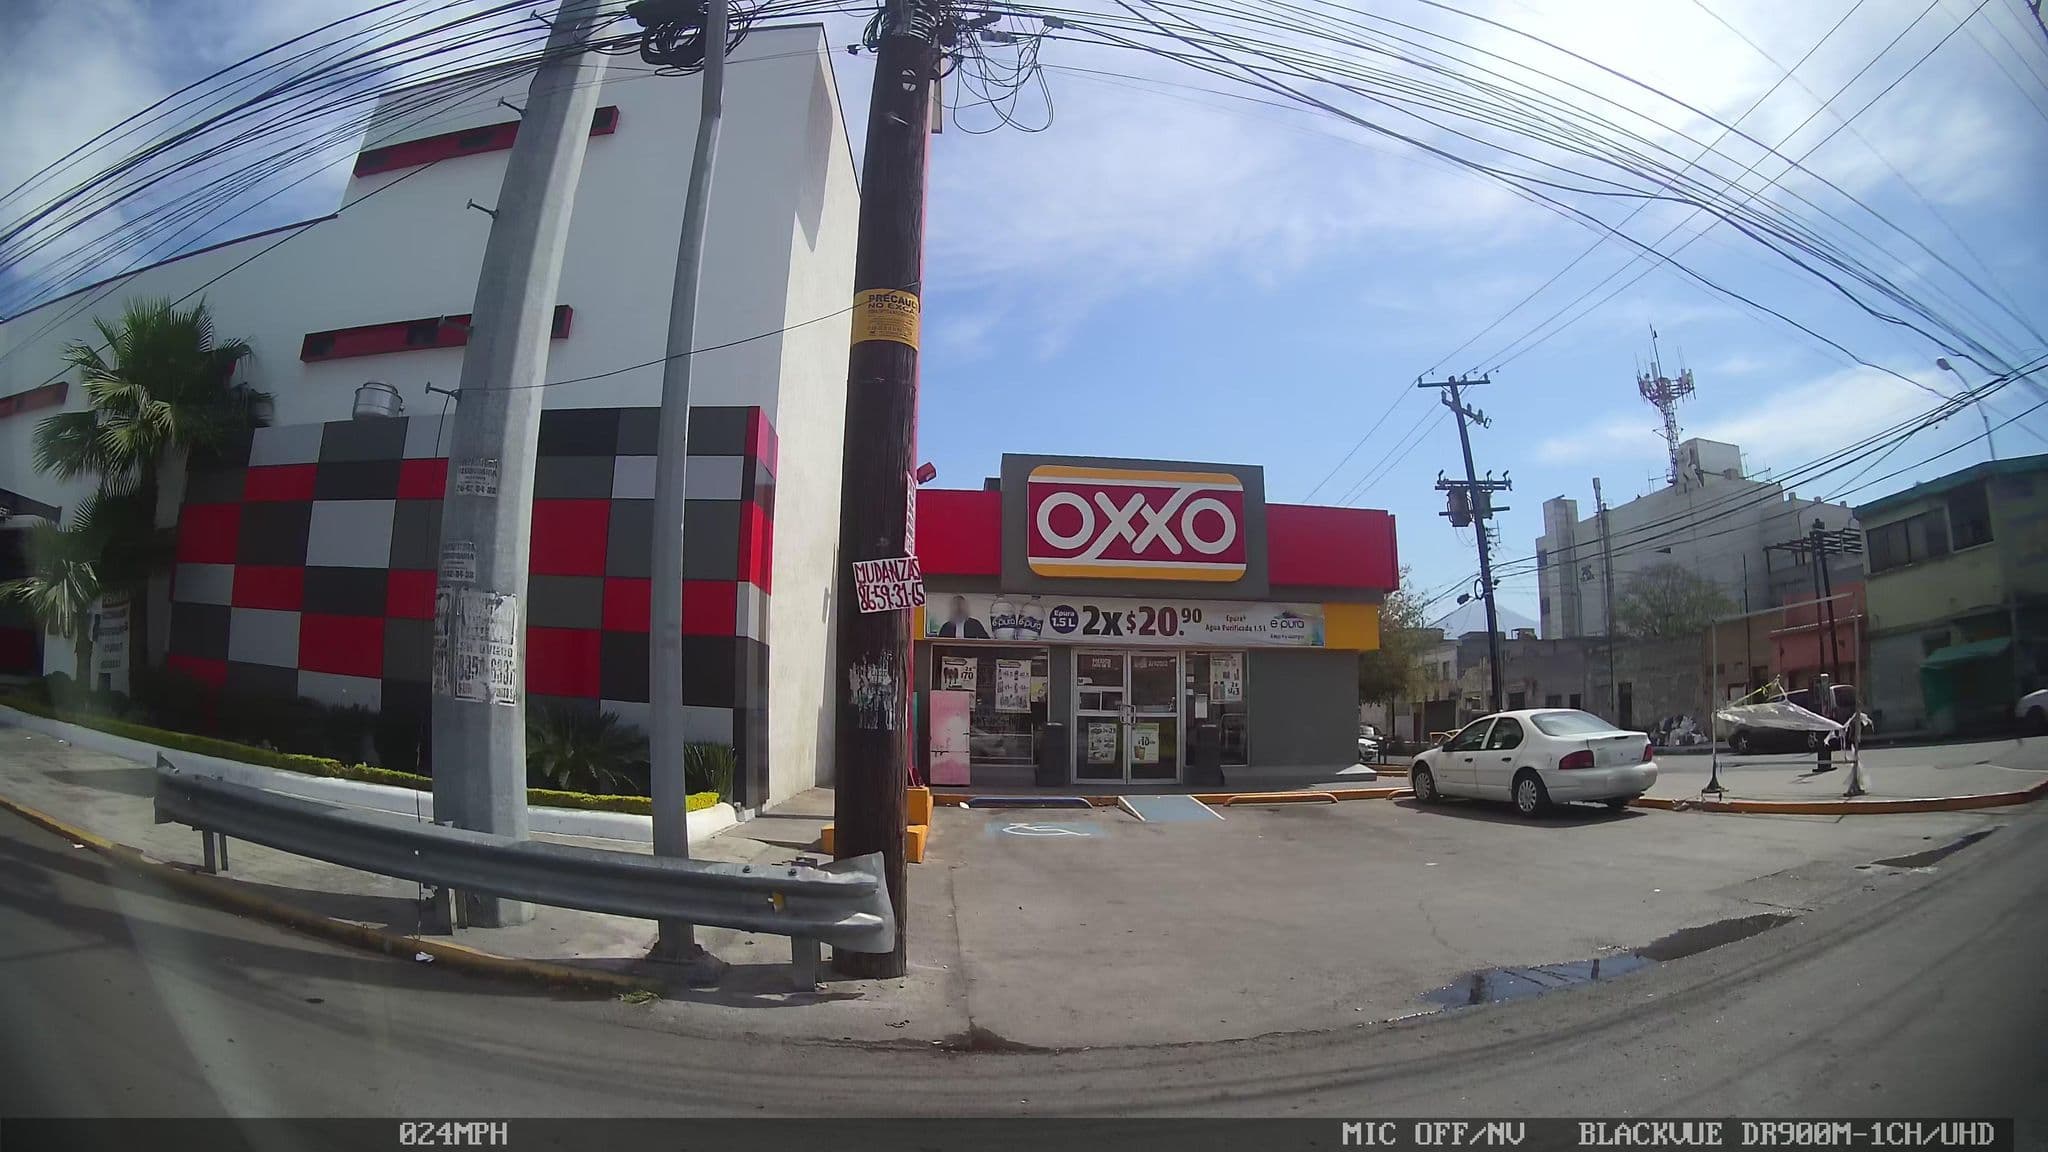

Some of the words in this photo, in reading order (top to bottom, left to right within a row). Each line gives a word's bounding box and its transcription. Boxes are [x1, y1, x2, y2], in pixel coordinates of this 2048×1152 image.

[1036, 489, 1238, 557] OXXO
[854, 558, 921, 583] MUDANZAS
[1054, 610, 1075, 618] Epura
[1205, 624, 1220, 632] Agua
